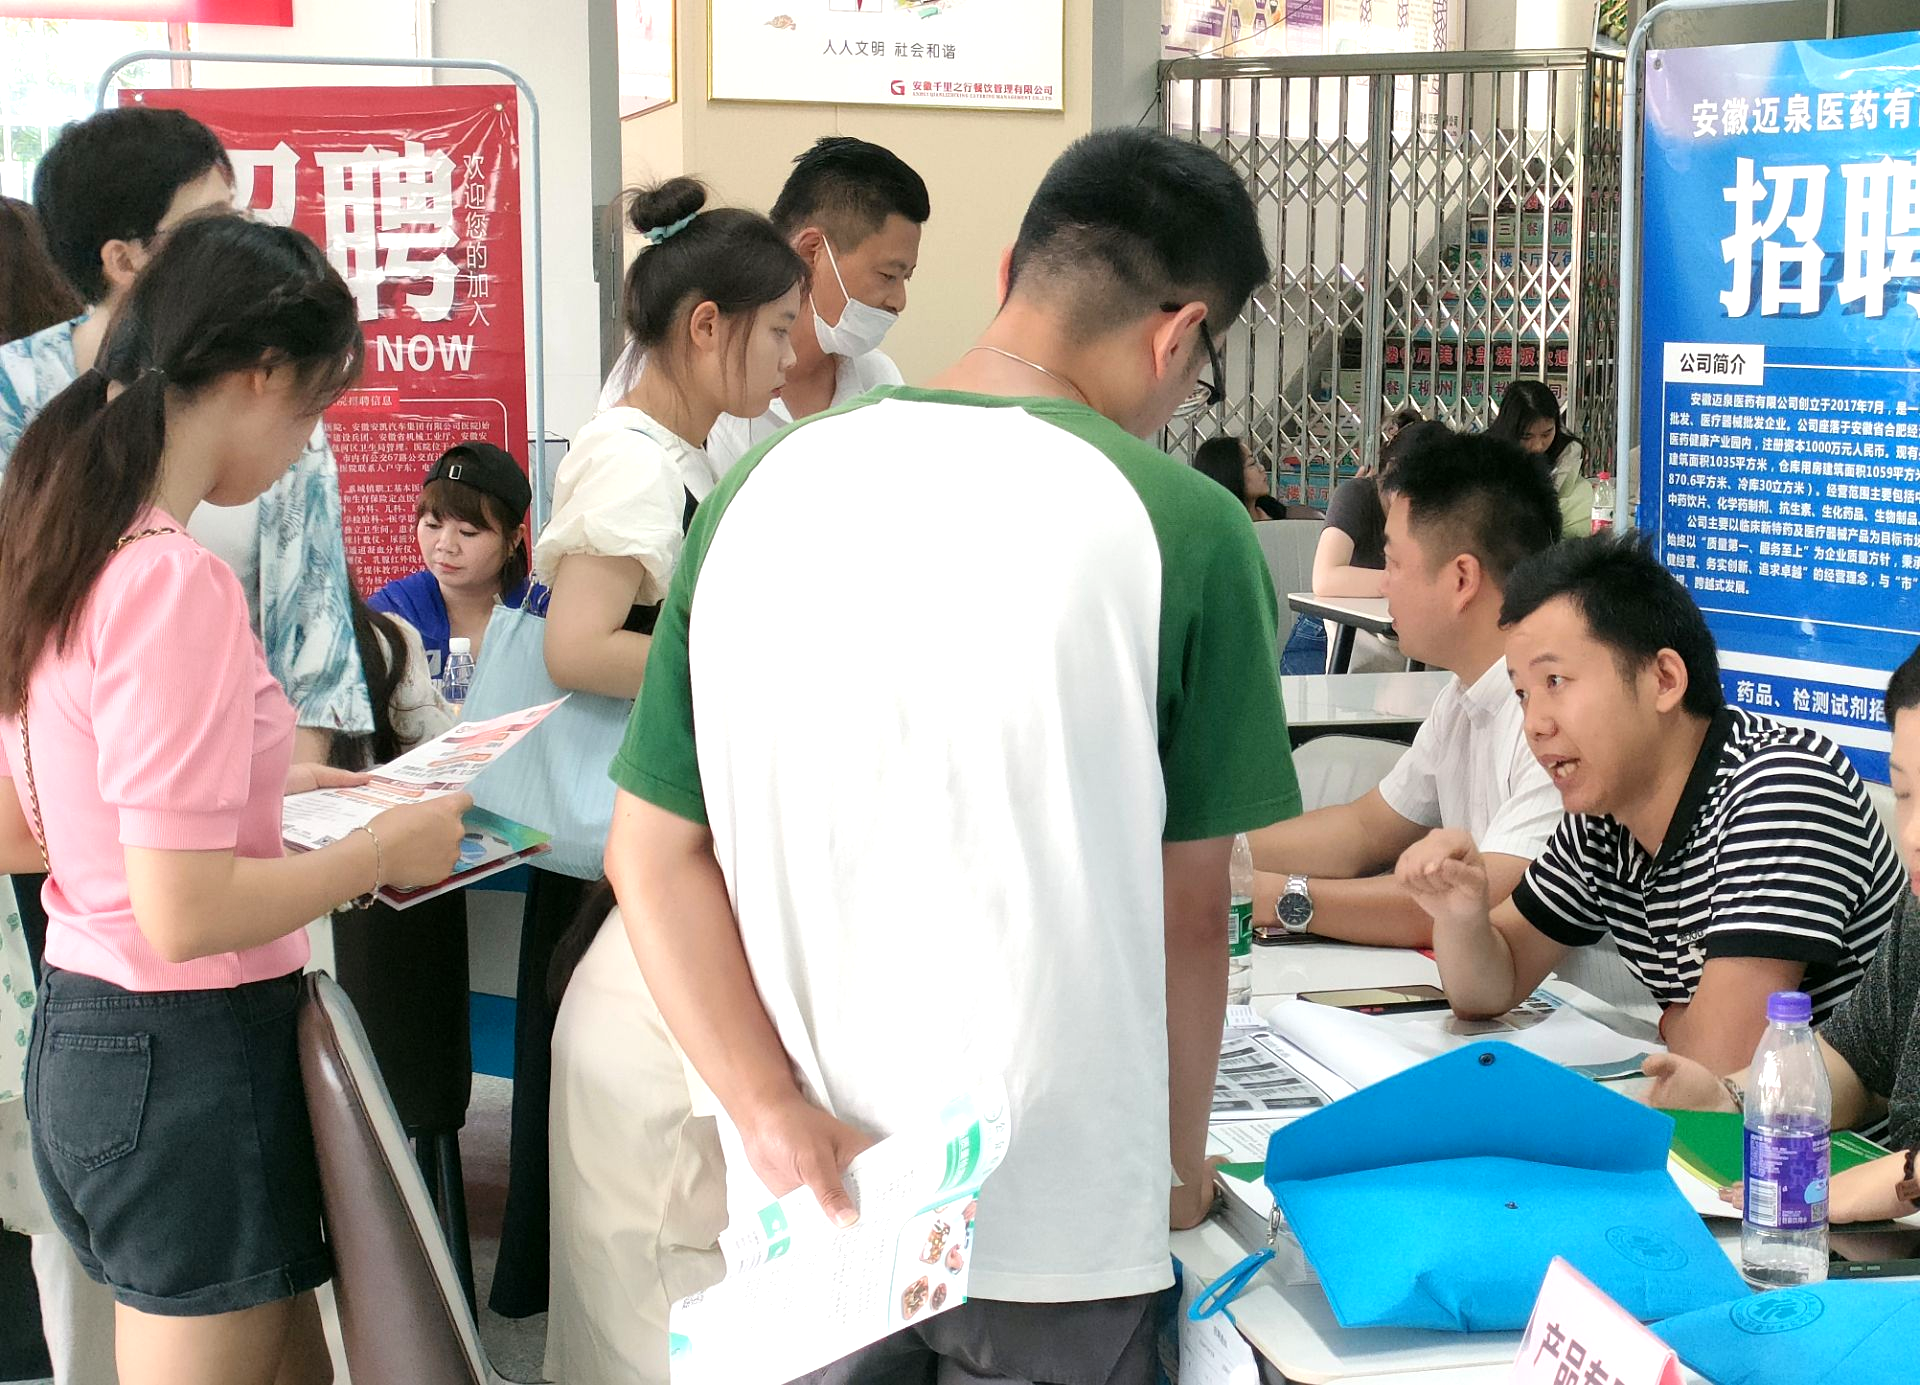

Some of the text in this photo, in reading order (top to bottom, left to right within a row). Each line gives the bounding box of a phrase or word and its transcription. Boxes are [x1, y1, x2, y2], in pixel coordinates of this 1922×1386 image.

[823, 39, 956, 59] 人人文明 社会和谐
[912, 80, 1054, 96] 安徽千里之行餐饮管理有限公司
[1692, 88, 1920, 138] 安徽迈泉医药有
[463, 152, 490, 327] 欢迎您的加入
[1719, 153, 1920, 319] 招聘
[376, 334, 475, 373] NOW
[1679, 352, 1747, 376] 公司简介
[1690, 391, 1920, 416] 安徽迈泉医药有限公司创立于2017年7月，是一
[1669, 411, 1920, 439] 批发、医疗器械批发企业。公司座落于安徽省合肥经
[1669, 432, 1920, 461] 医药健康产业园内，注册资本1000万元人民币。现有
[1670, 572, 1751, 596] 、跨越式发展。
[1736, 680, 1887, 724] 药品、检测试剂招
